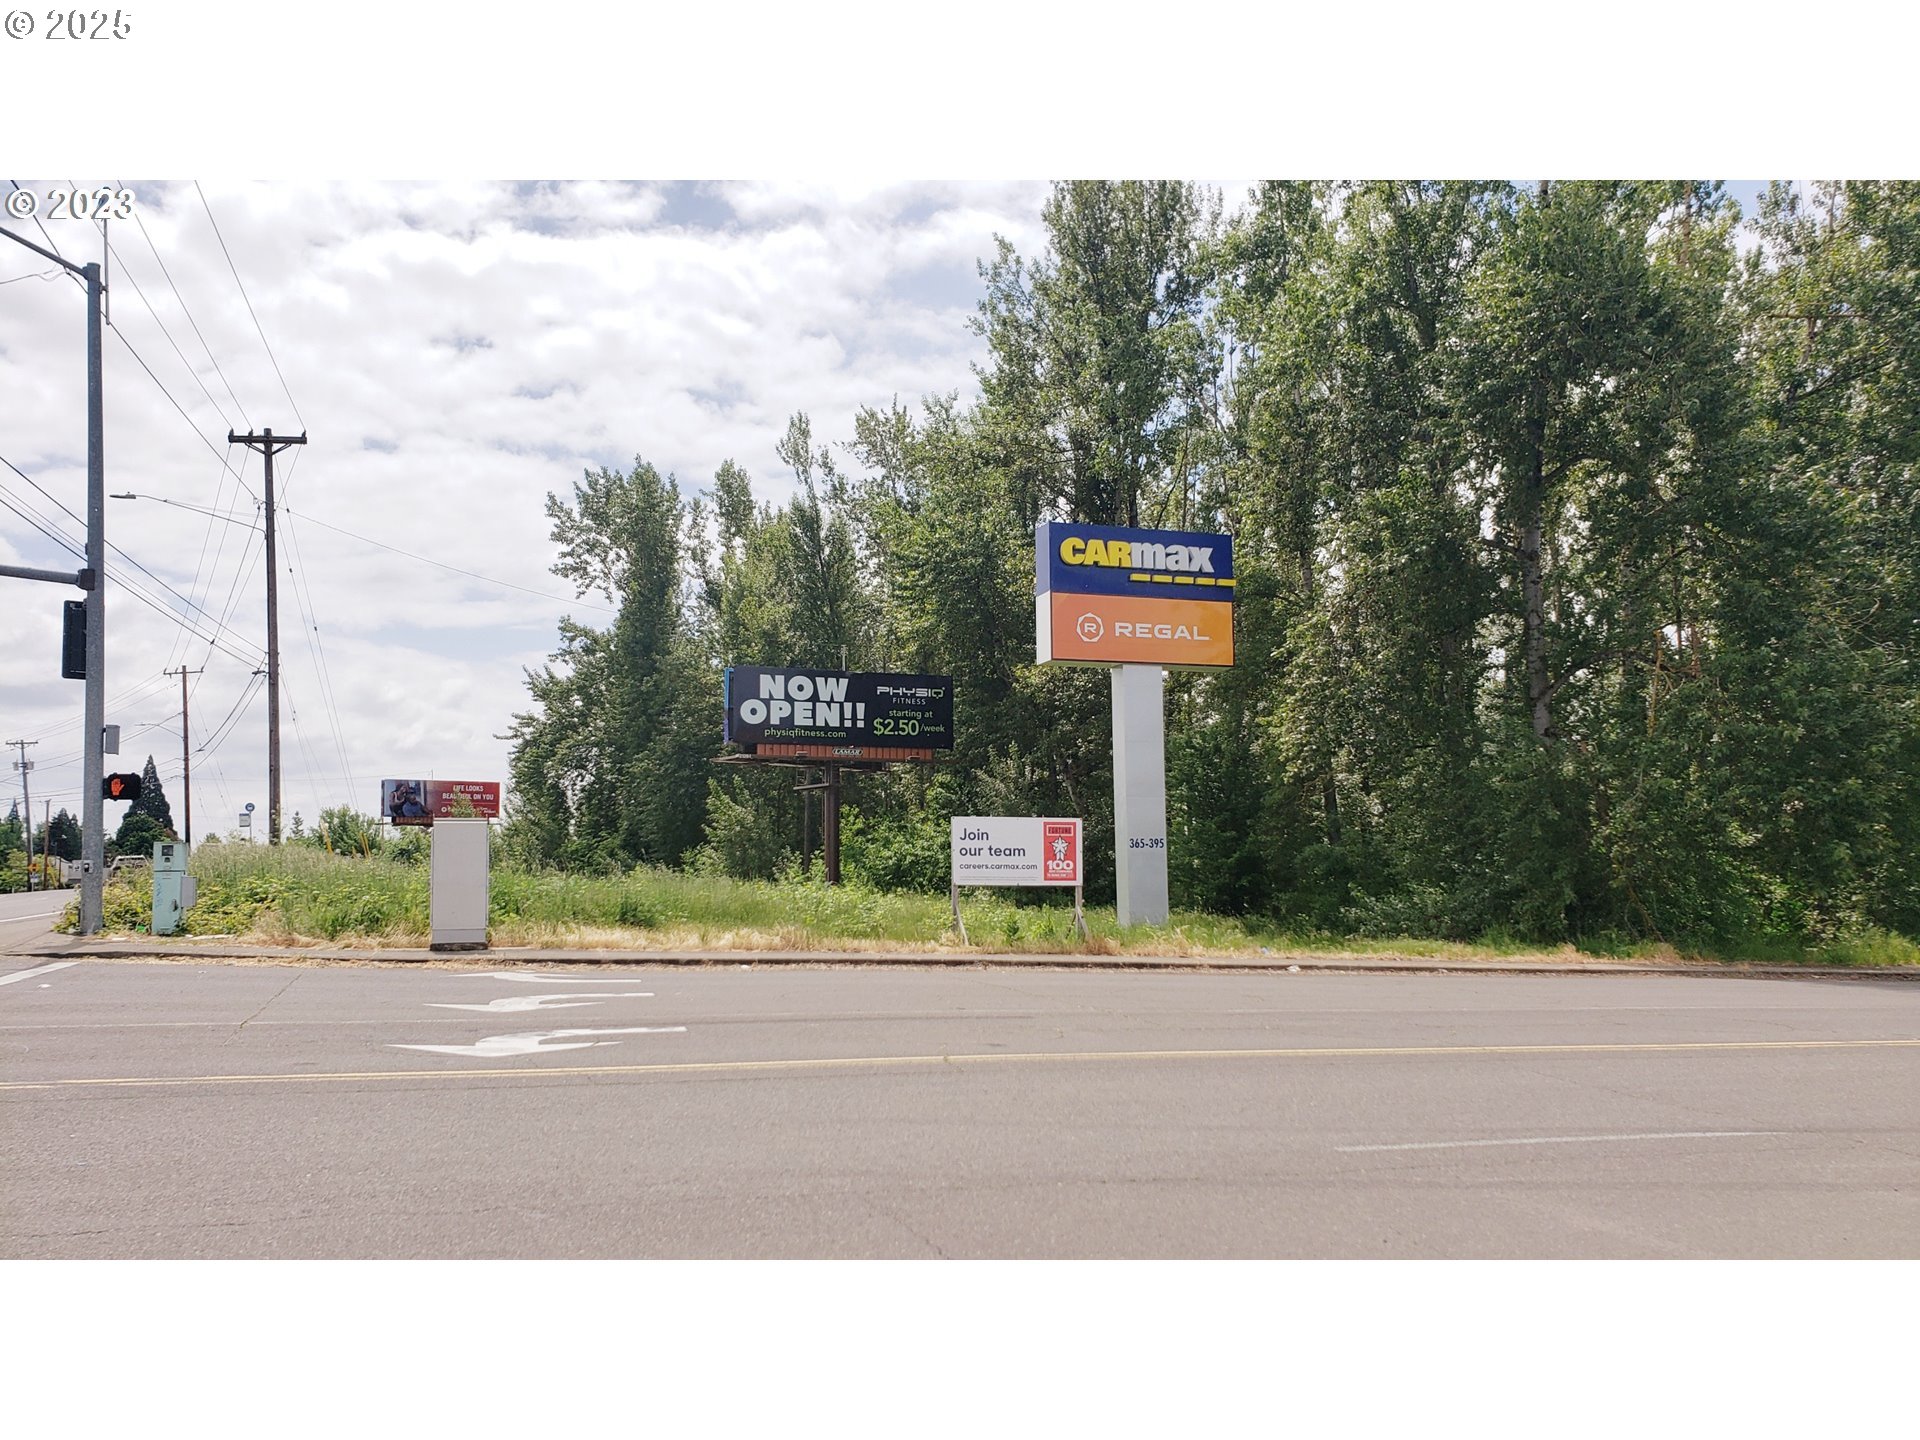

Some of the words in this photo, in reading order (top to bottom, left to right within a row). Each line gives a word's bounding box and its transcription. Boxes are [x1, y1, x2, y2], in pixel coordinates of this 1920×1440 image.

[1060, 537, 1214, 573] CARmax
[1115, 622, 1211, 641] REGAL
[760, 674, 849, 702] NOW
[876, 686, 944, 699] PHYSIQ
[892, 697, 926, 705] FITNESS
[740, 699, 866, 728] OPEN!!
[889, 709, 922, 719] starting
[764, 728, 847, 738] physiqfitness.com
[873, 717, 919, 736] $2.50
[959, 828, 989, 841] Join
[1129, 838, 1164, 849] 365-395
[959, 847, 983, 857] our
[988, 845, 1026, 857] team
[1046, 860, 1074, 870] 100
